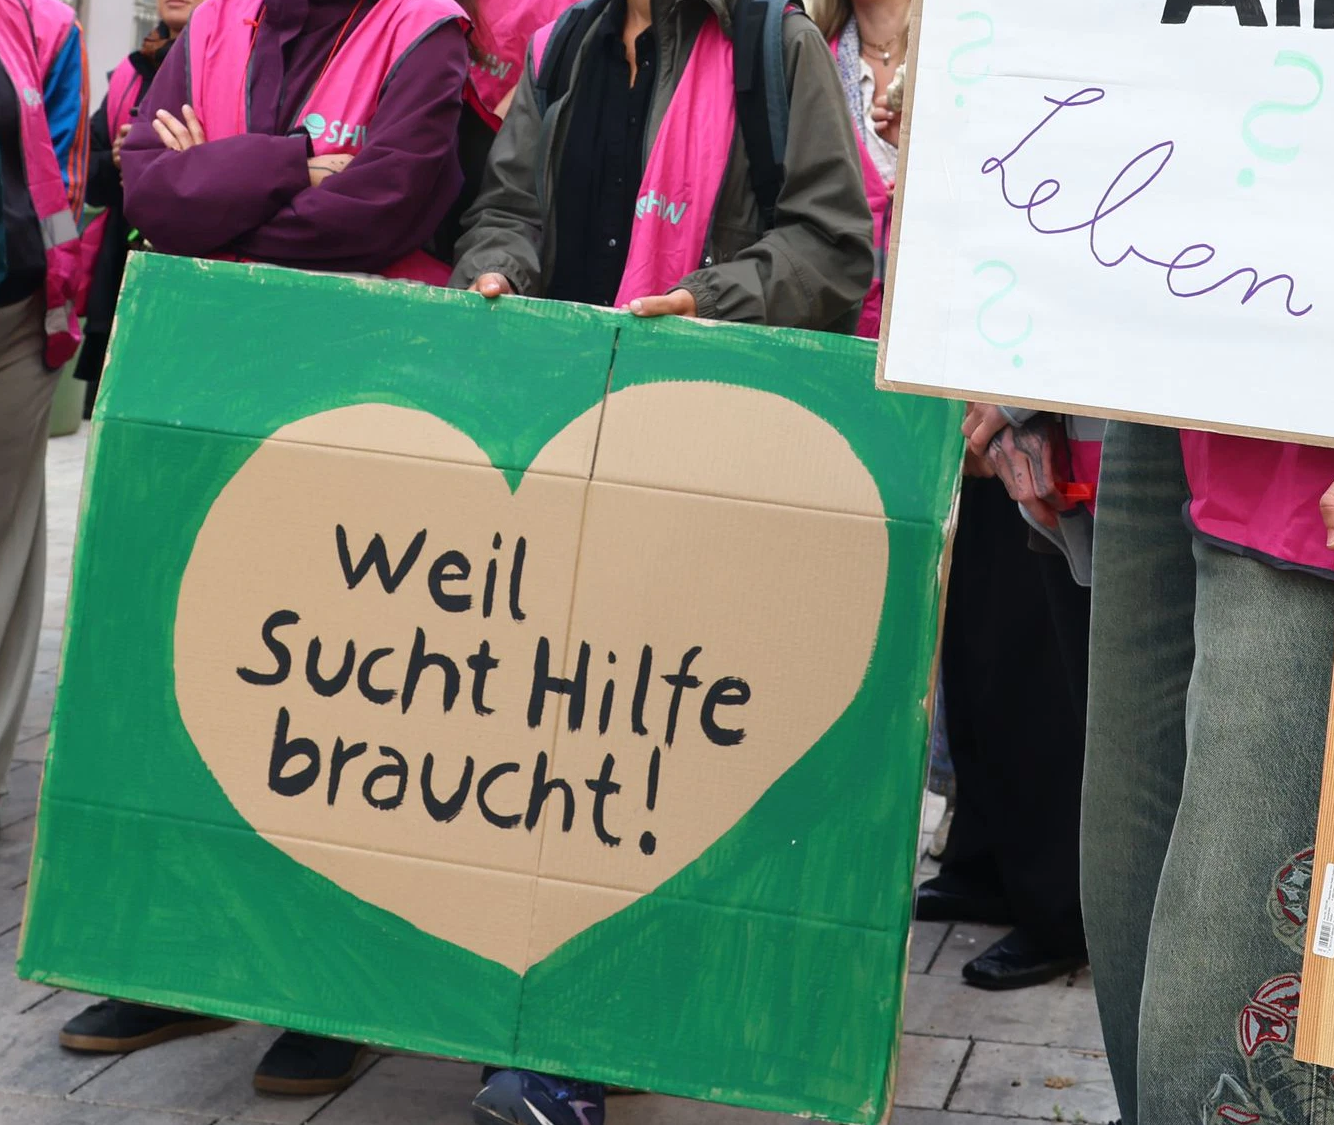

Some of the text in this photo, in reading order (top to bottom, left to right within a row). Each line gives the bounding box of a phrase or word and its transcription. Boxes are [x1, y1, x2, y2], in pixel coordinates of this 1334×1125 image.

[324, 120, 368, 147] SH
[980, 86, 1314, 318] Leben
[235, 609, 752, 748] Sucht Hilfe
[267, 706, 662, 856] braucht!
